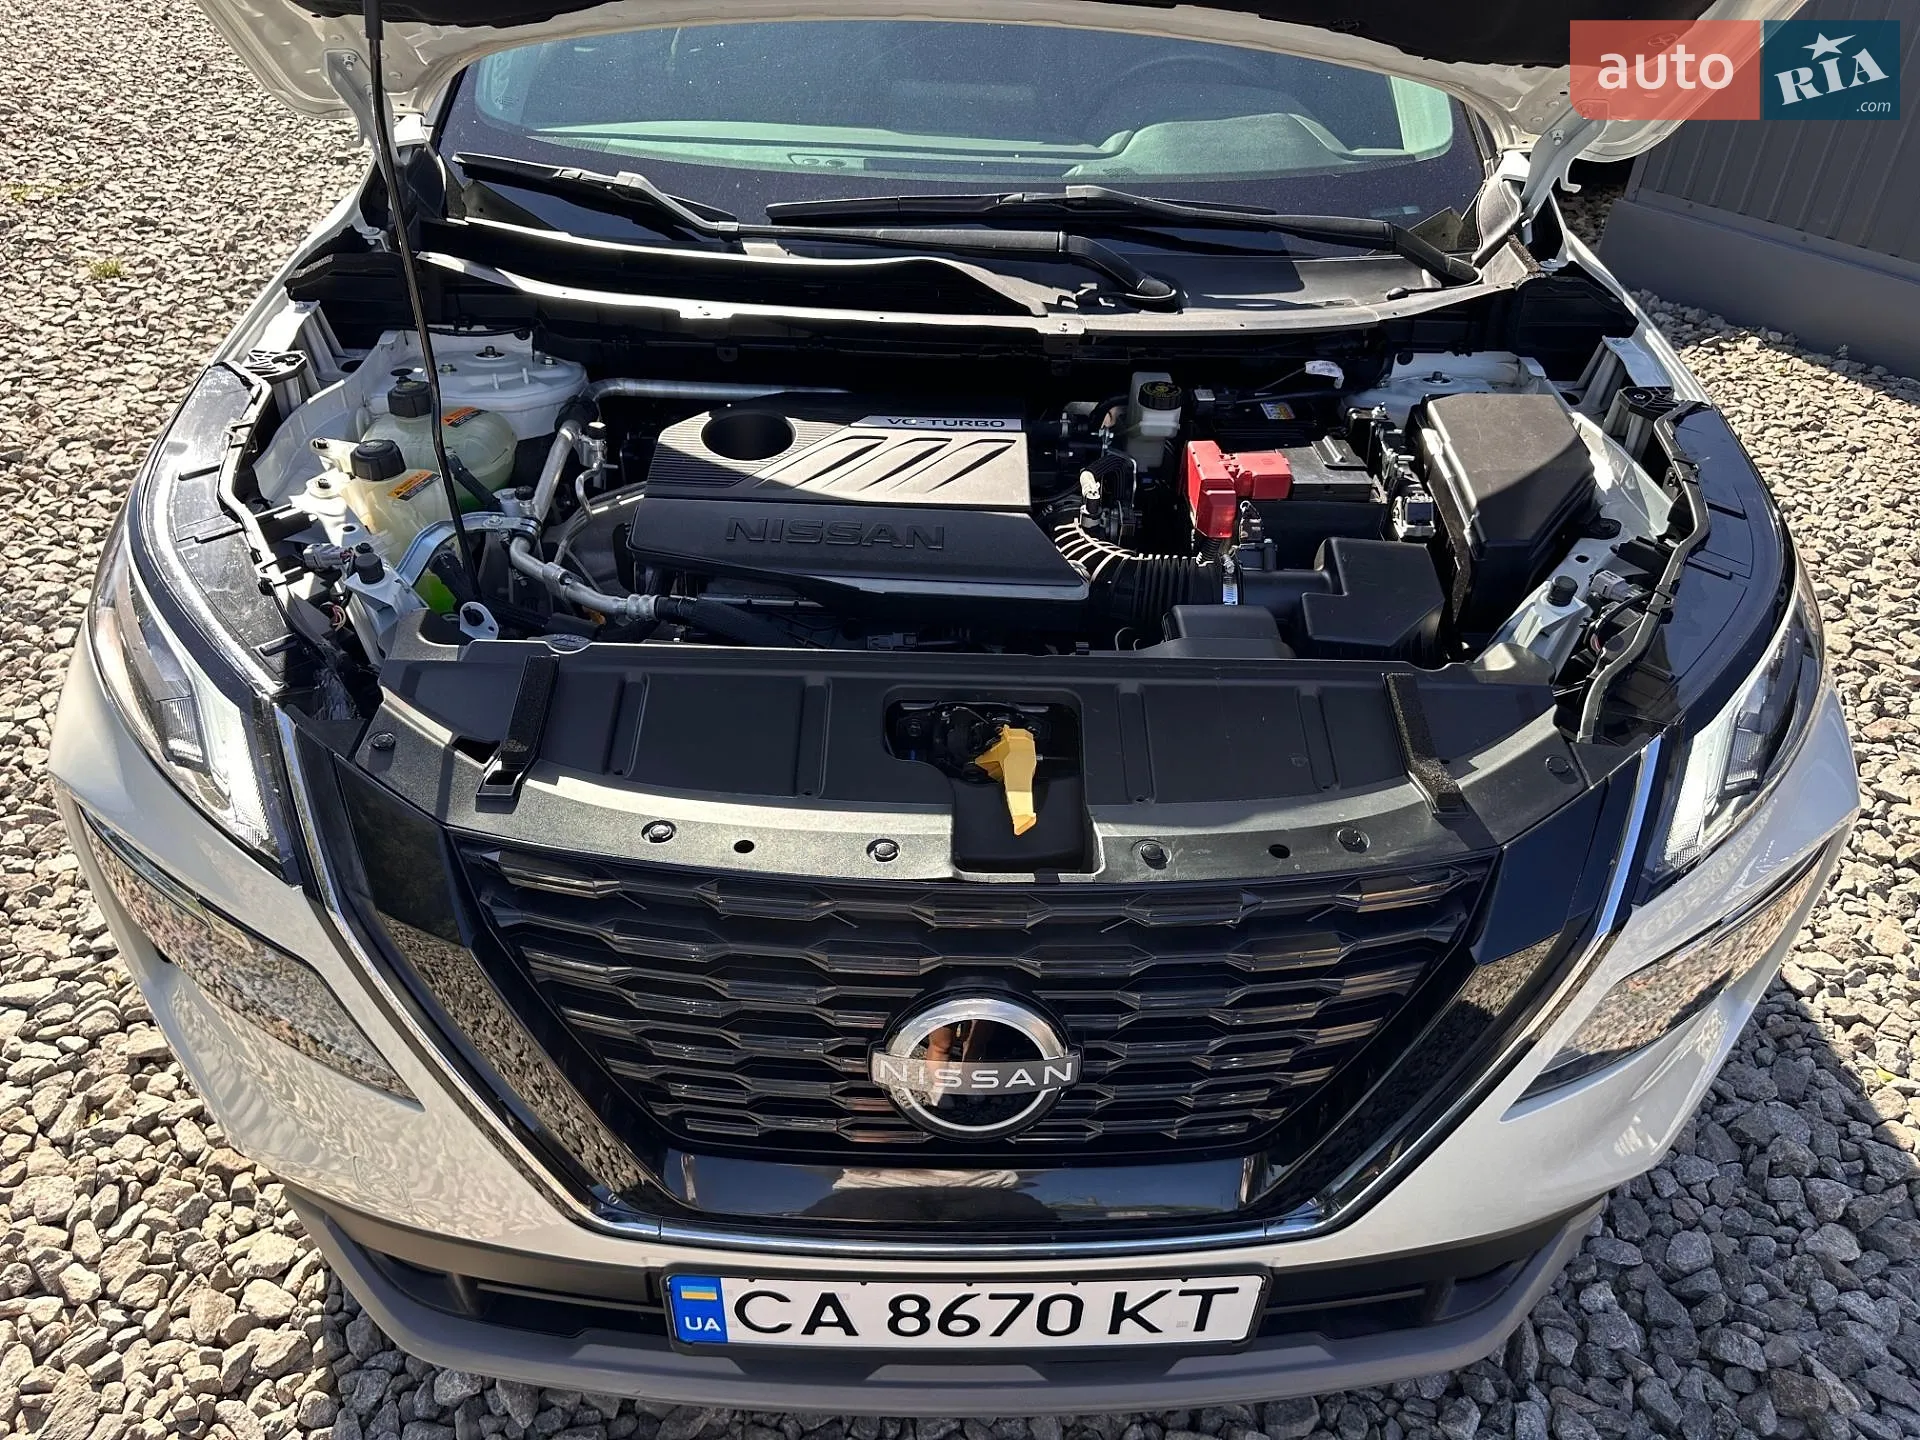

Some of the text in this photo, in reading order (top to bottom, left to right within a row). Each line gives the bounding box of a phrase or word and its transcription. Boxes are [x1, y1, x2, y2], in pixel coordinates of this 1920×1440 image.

[887, 418, 1006, 428] VC-TURBO
[725, 516, 945, 550] NISSAN
[878, 1060, 1073, 1089] NISSAN
[684, 1316, 721, 1332] UA
[734, 1286, 1240, 1337] CA 8670 KT
